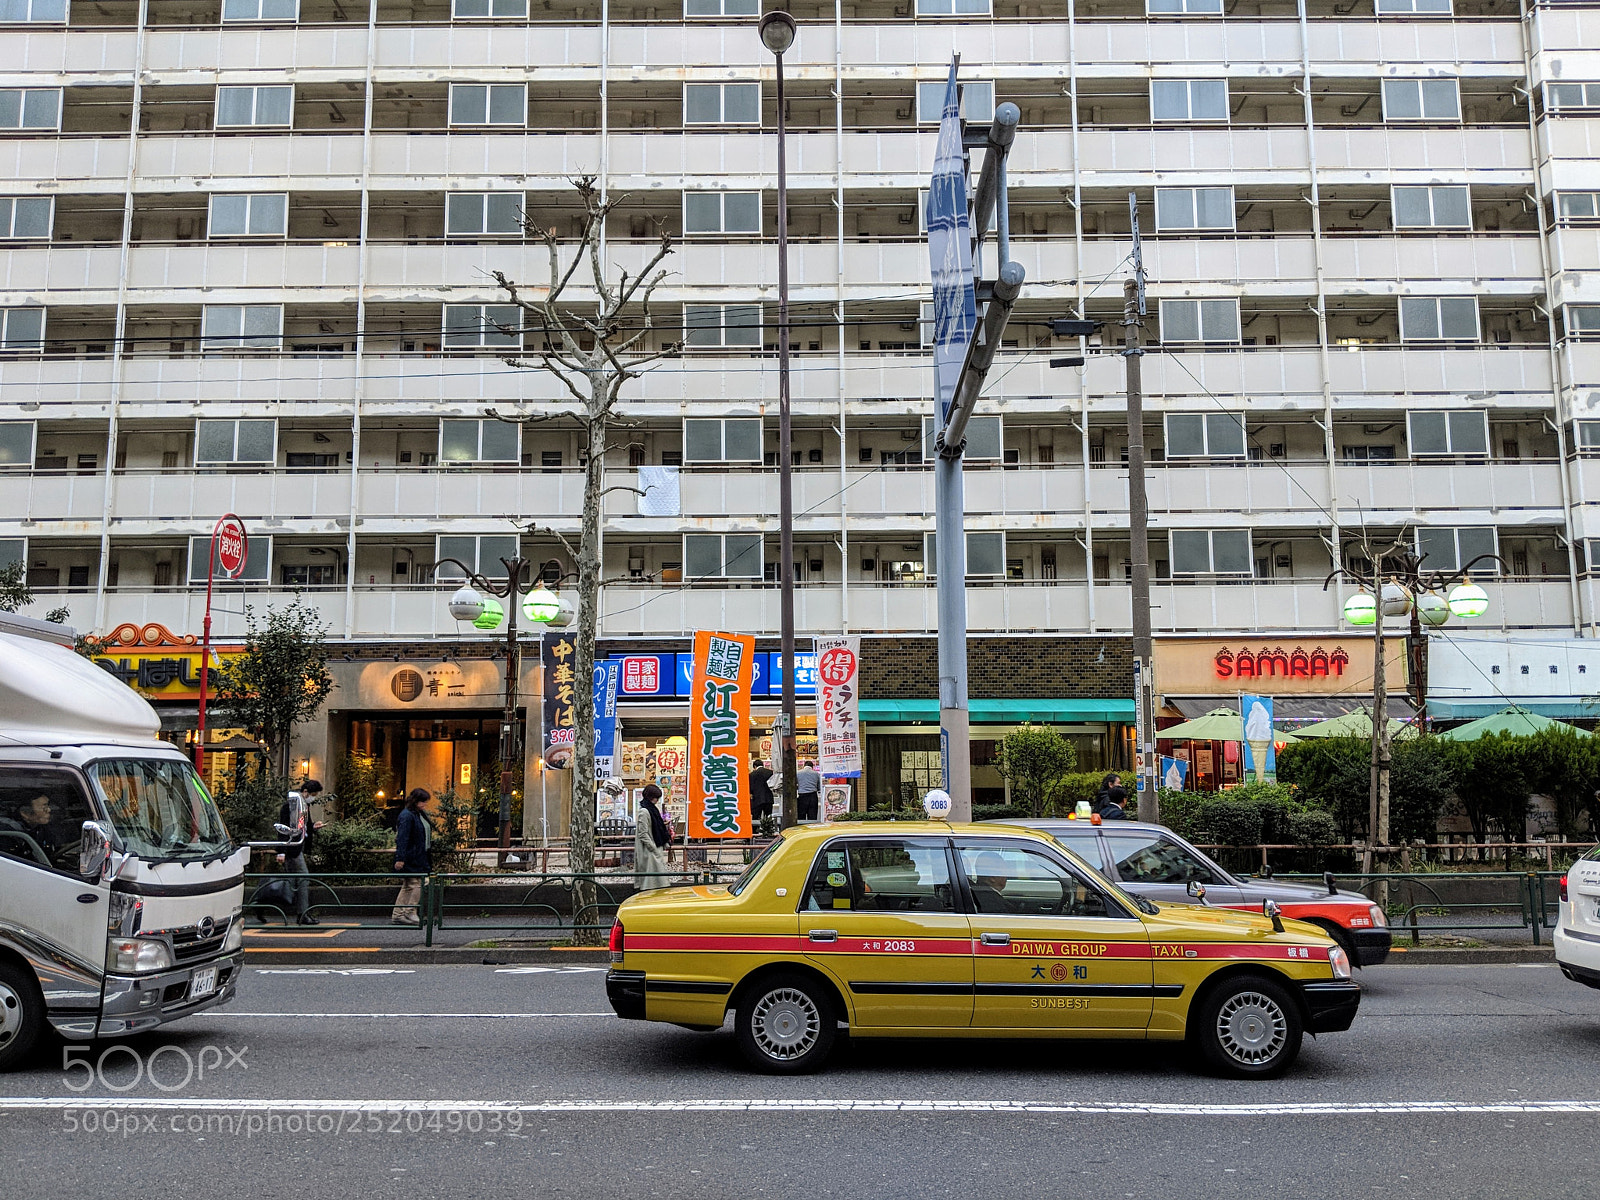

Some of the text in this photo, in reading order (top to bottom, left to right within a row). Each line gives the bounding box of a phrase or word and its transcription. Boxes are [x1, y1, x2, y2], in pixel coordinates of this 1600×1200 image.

[221, 535, 240, 559] 消火栓
[823, 652, 852, 682] 得
[1216, 648, 1348, 677] SAMRAT
[426, 677, 465, 698] 青一
[834, 685, 853, 729] ランチ
[702, 681, 741, 834] 江戸蕎麦
[931, 800, 948, 809] 2083
[862, 941, 915, 952] 大和 2083
[1012, 943, 1184, 957] DAIWA GROUP TAXI
[1030, 998, 1090, 1009] SUNBEST
